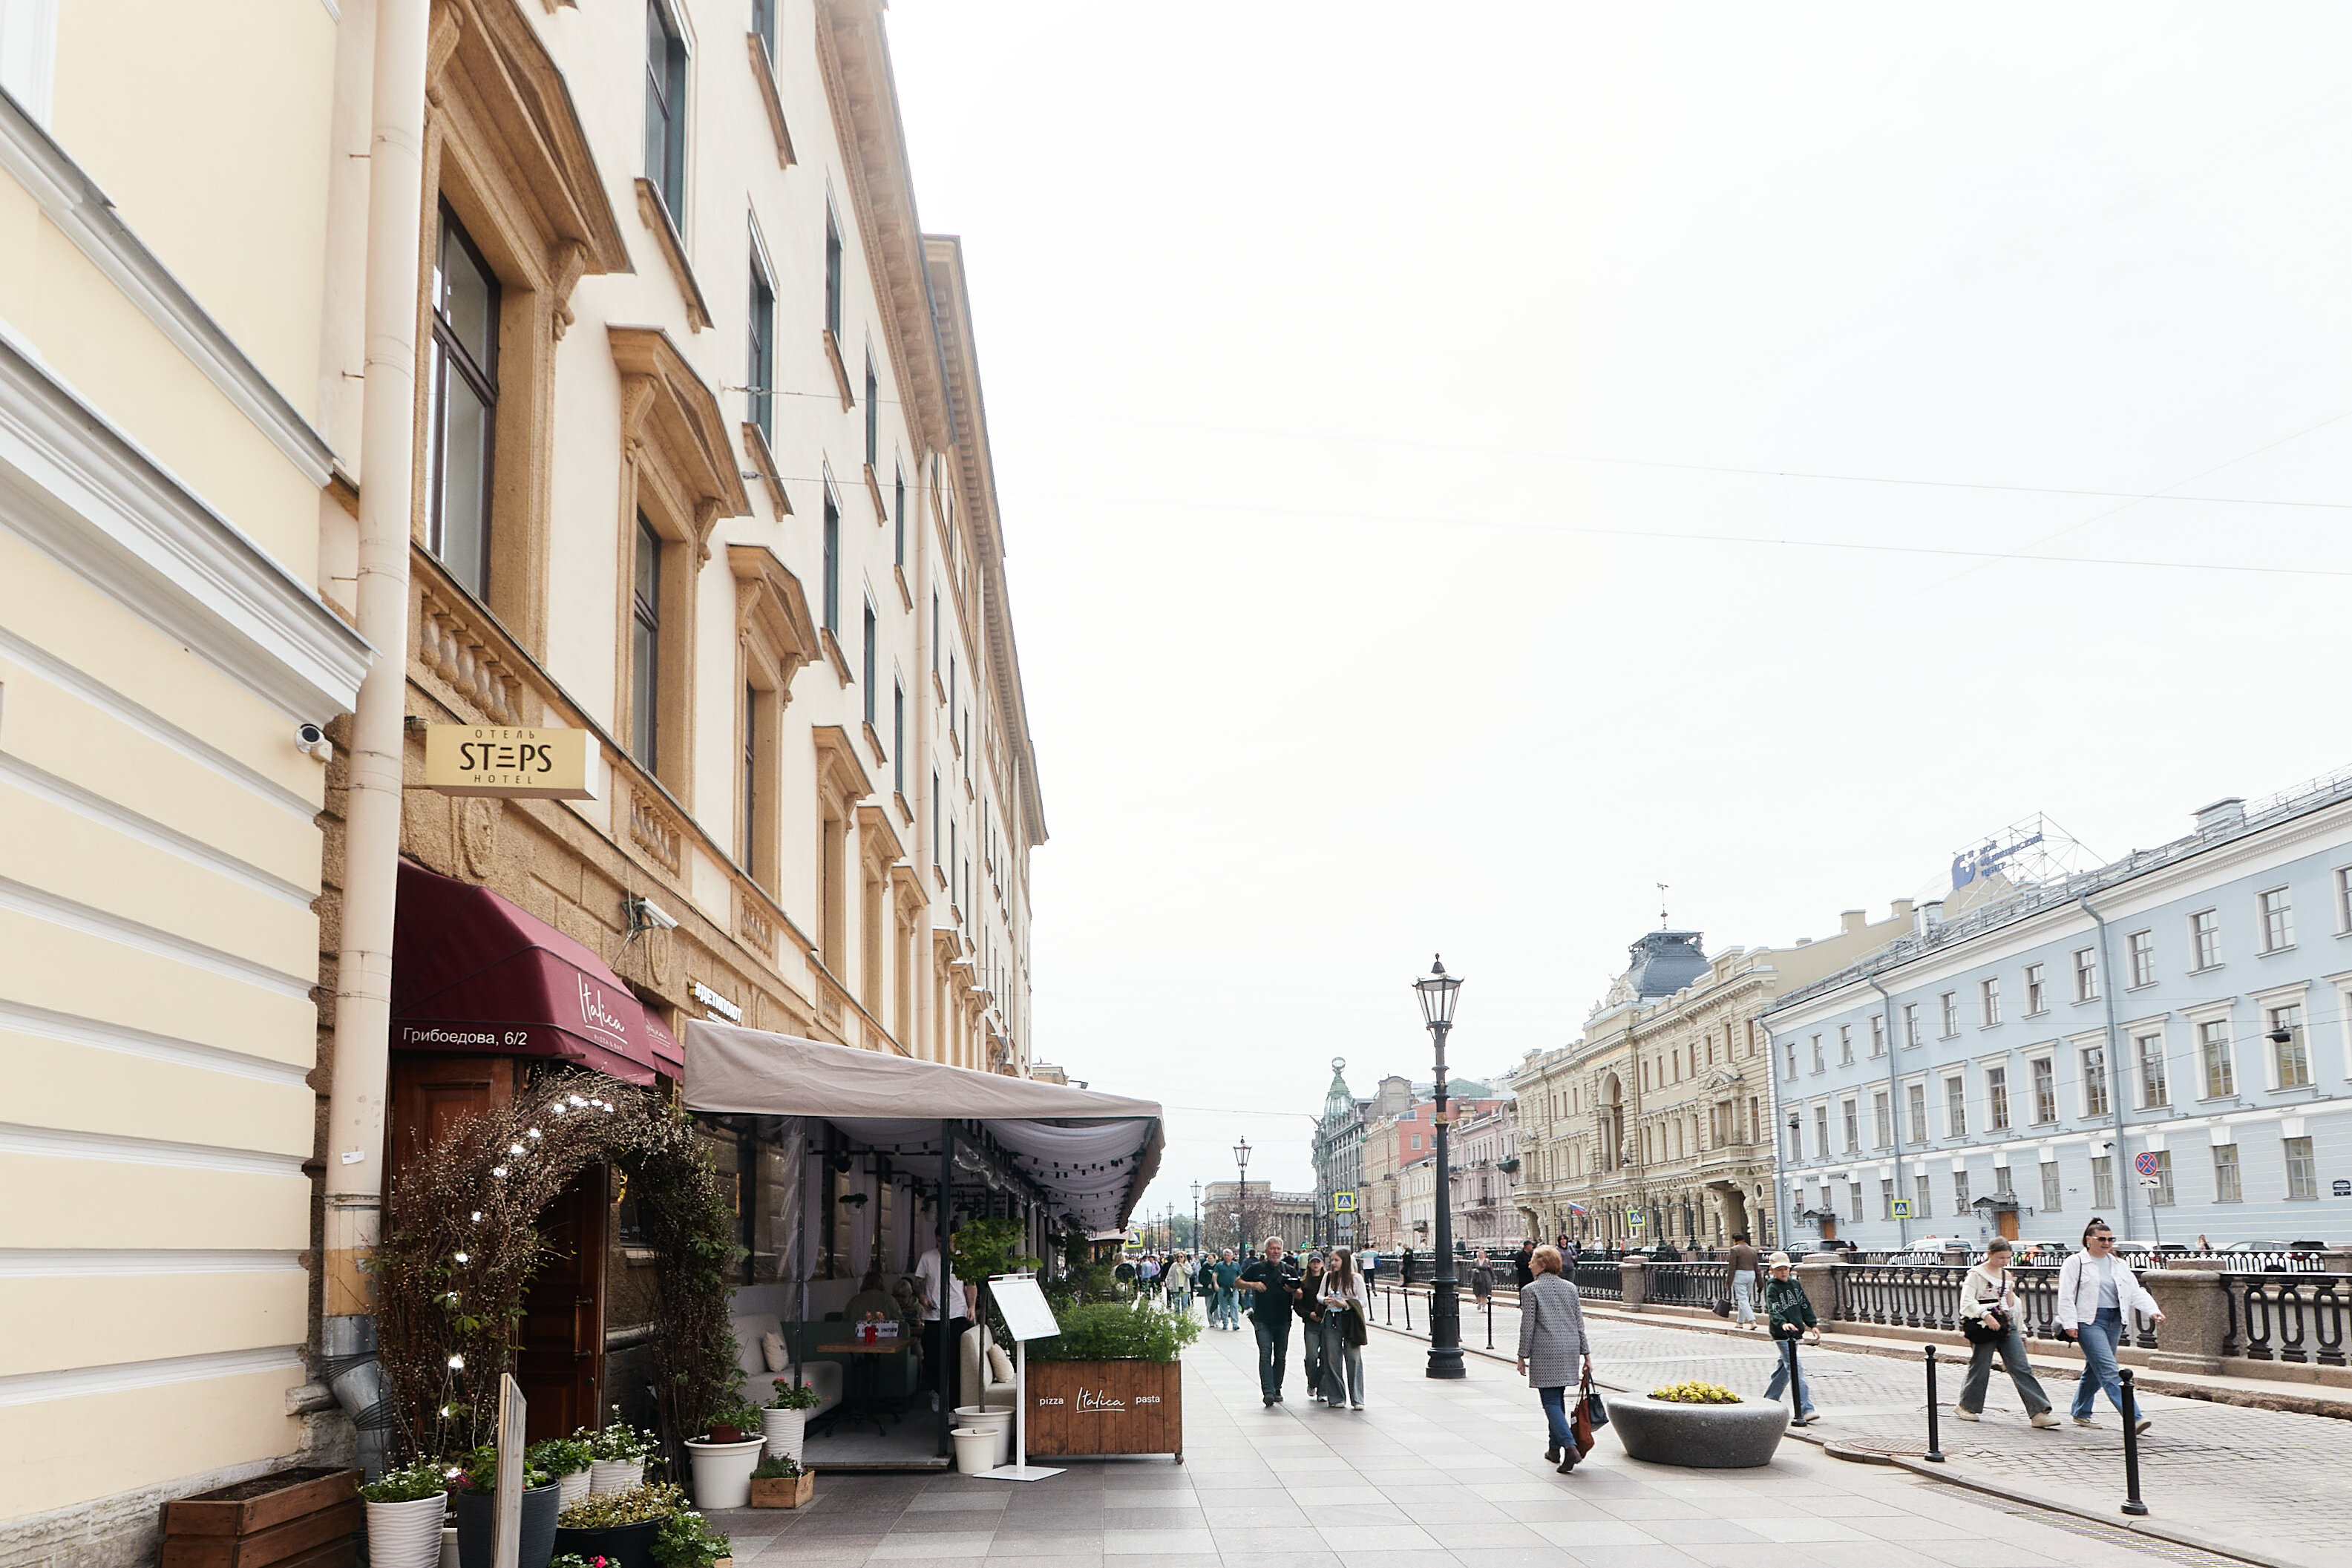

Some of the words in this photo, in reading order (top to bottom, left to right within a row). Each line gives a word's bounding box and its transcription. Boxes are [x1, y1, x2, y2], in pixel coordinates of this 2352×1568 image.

[475, 729, 535, 739] ОТЕЛЬ
[459, 742, 551, 772] STEPS
[474, 775, 532, 784] HOTEL
[577, 973, 625, 1032] Italica
[695, 981, 742, 1023] #ДЕТИПОЮТ
[403, 1027, 499, 1046] Грибоедова,
[505, 1031, 528, 1046] 6/2
[1039, 1396, 1064, 1406] pizza
[1076, 1386, 1126, 1411] Italica
[1136, 1395, 1160, 1405] pasta
